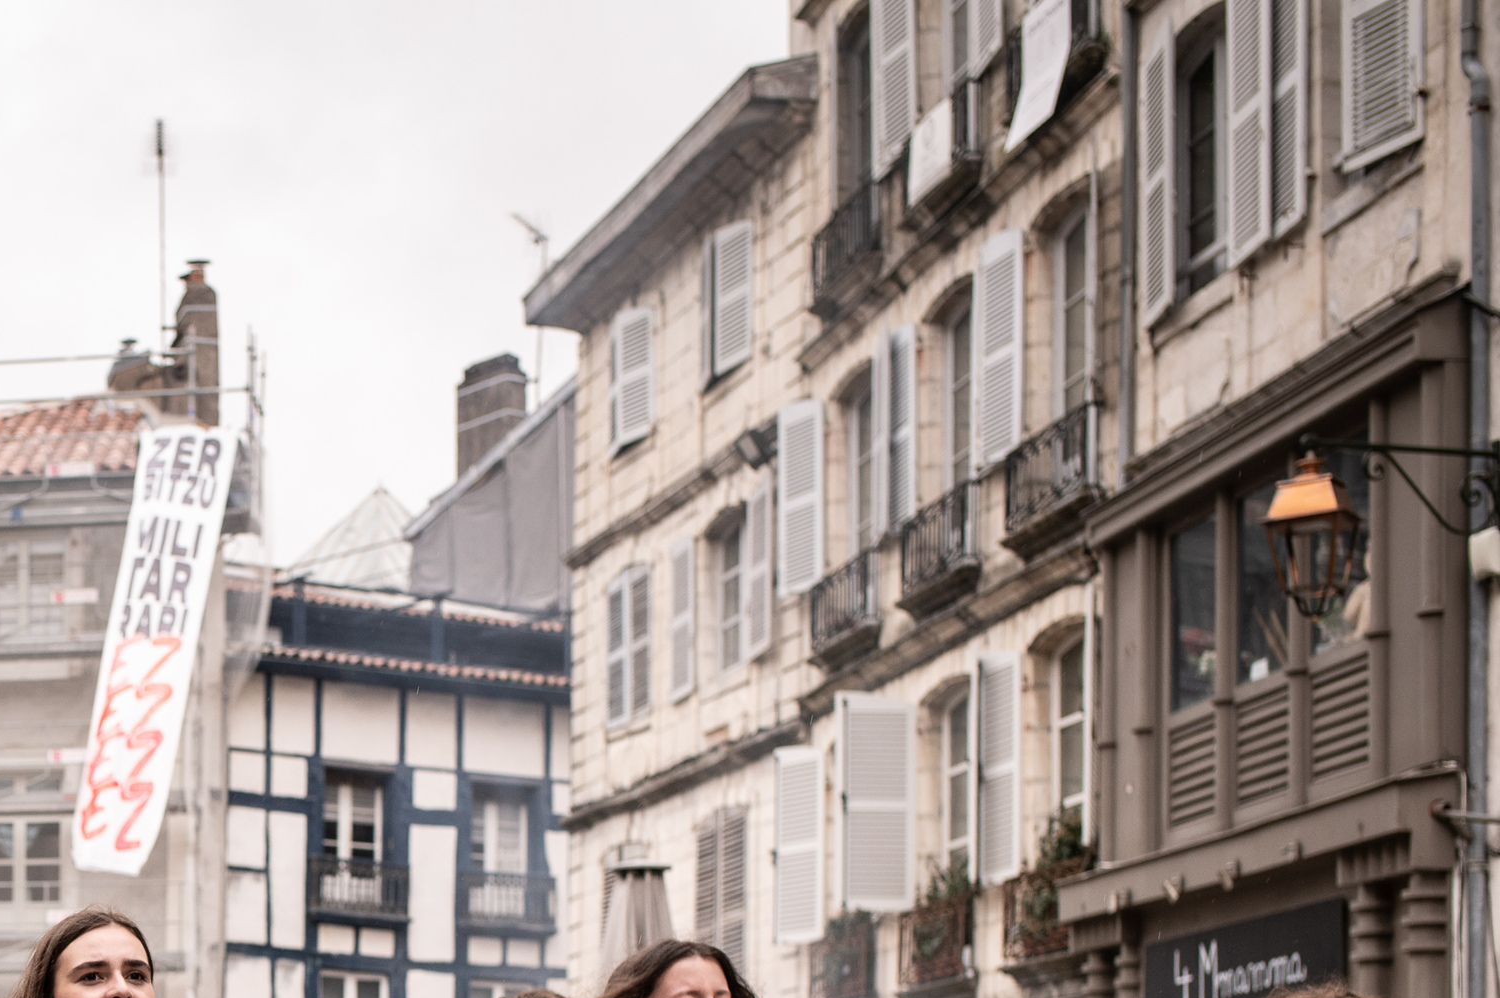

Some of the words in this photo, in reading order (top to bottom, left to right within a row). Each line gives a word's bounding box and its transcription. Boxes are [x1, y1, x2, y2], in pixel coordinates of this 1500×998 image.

[148, 436, 221, 477] ZER
[139, 516, 203, 559] MILI
[127, 557, 192, 603] TAR
[80, 781, 155, 850] EZ
